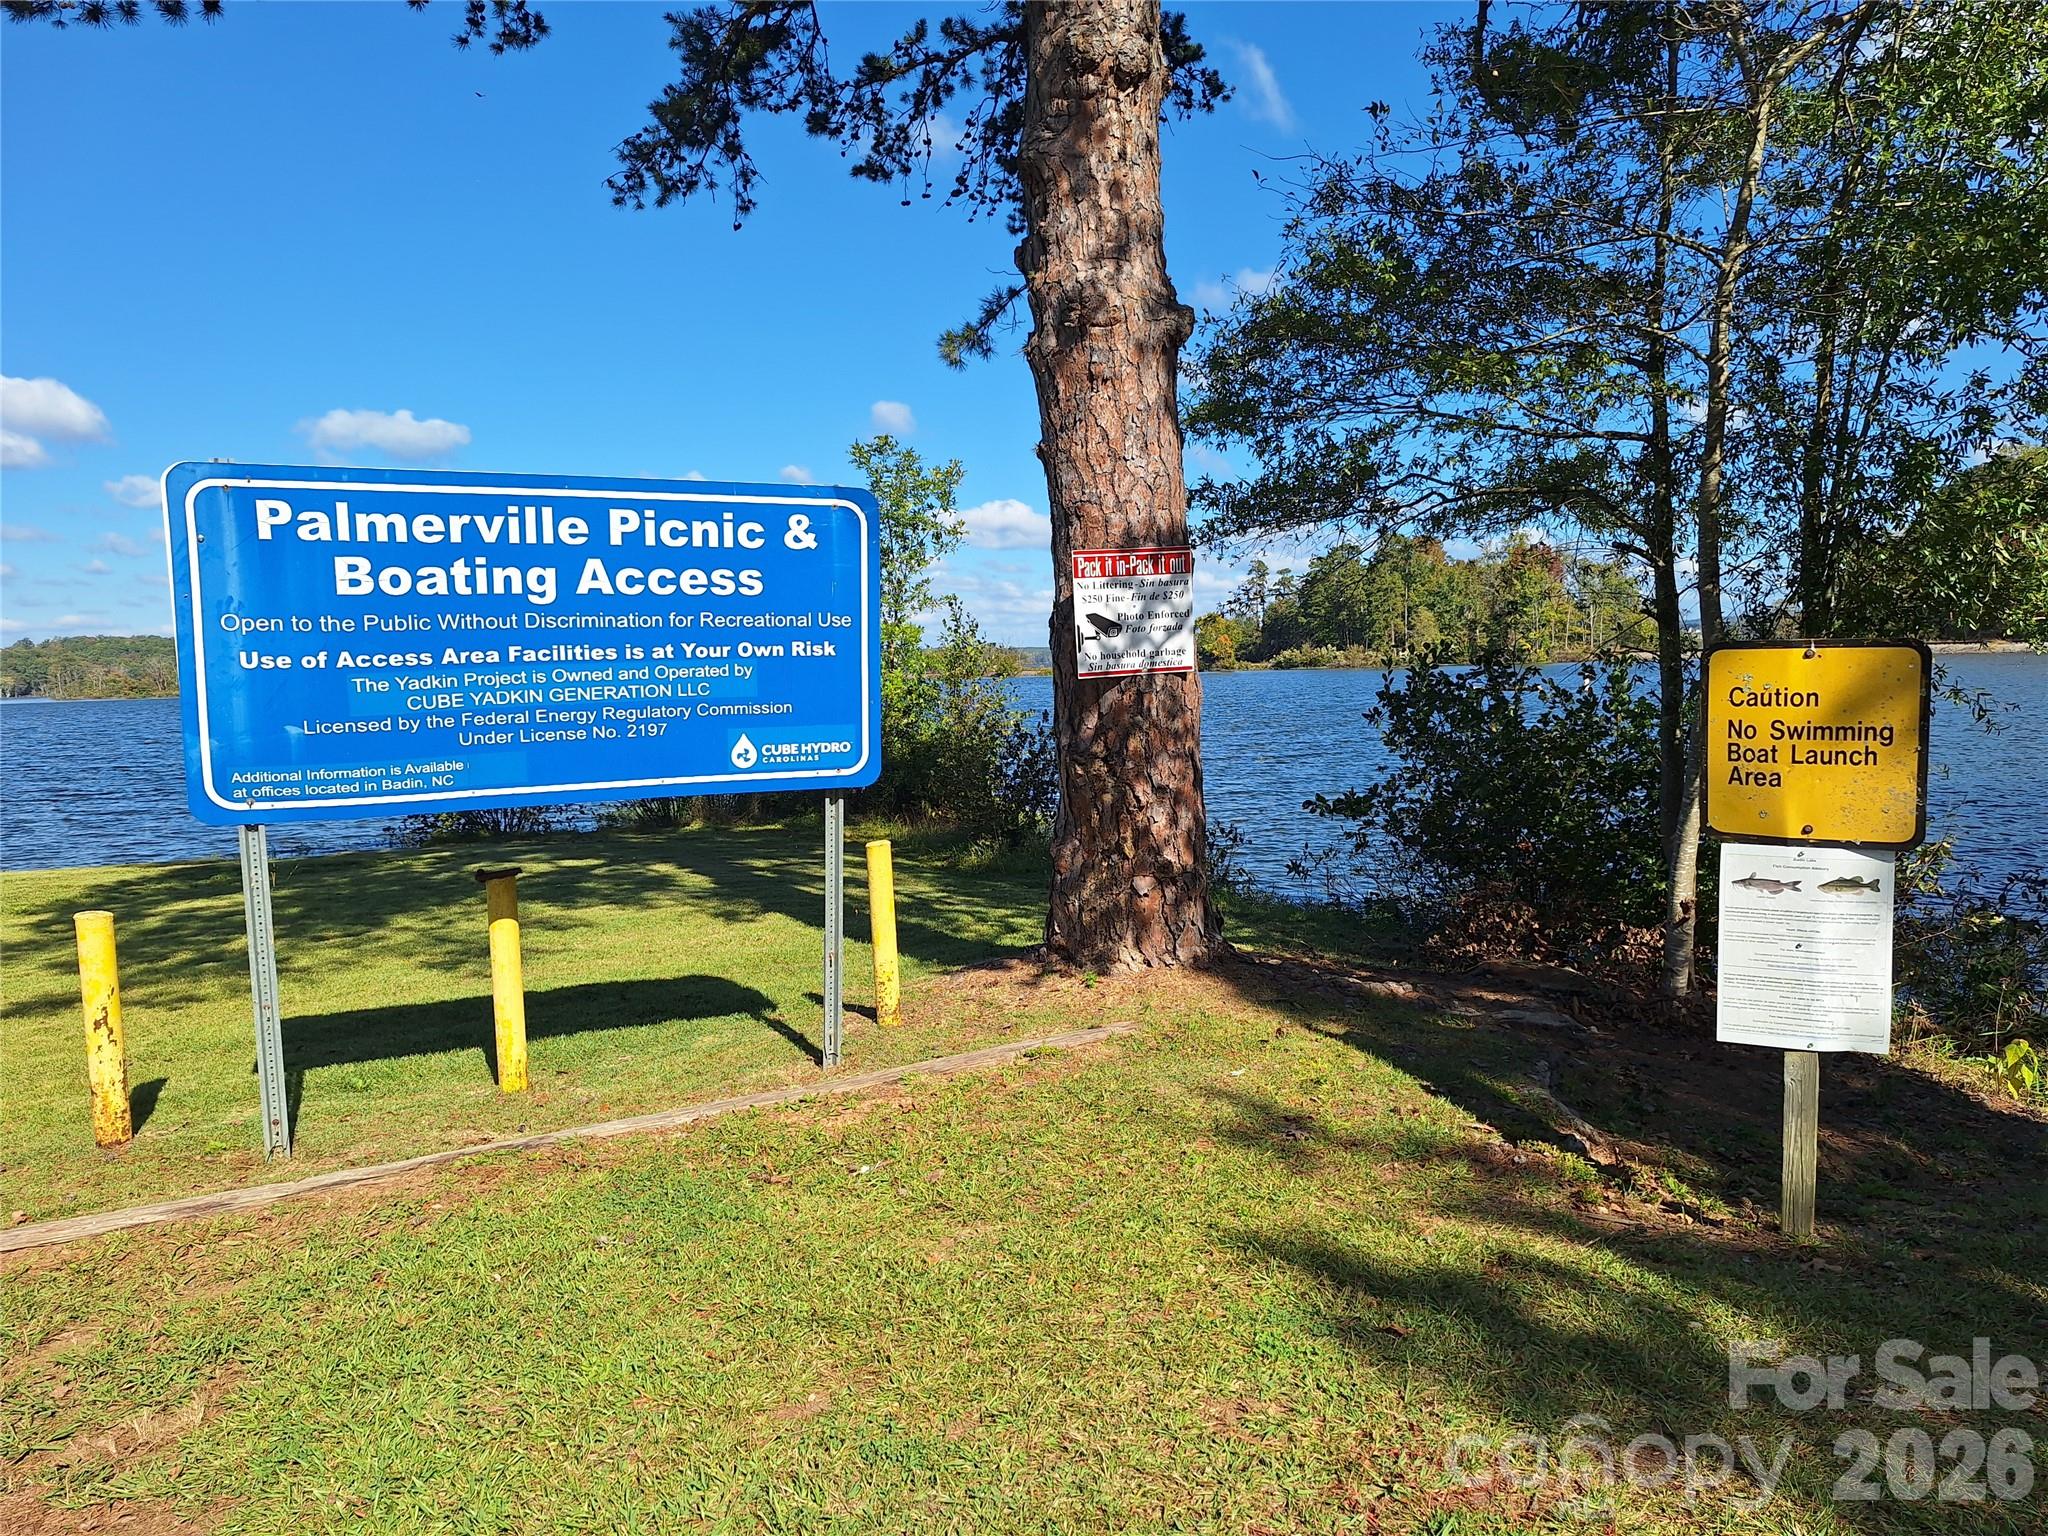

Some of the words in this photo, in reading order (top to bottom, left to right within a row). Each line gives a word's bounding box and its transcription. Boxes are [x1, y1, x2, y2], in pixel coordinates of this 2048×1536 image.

[255, 499, 589, 545] Palmerville
[608, 508, 766, 549] Picnic
[783, 513, 819, 550] &
[1077, 557, 1102, 577] Pack
[1105, 558, 1112, 577] it
[1158, 554, 1166, 574] it
[1170, 554, 1186, 574] out
[334, 556, 557, 605] Boating
[576, 558, 764, 596] Access
[1077, 582, 1089, 590] No
[1158, 578, 1189, 588] basura
[1082, 594, 1103, 604] $250
[1150, 591, 1160, 601] de
[1163, 590, 1184, 600] $250
[220, 613, 284, 635] Open
[291, 615, 313, 632] to
[319, 615, 356, 632] the
[363, 614, 432, 631] Public
[437, 613, 518, 630] Without
[524, 612, 663, 629] Discrimination
[669, 612, 694, 628] for
[700, 611, 812, 628] Recreational
[818, 612, 852, 628] Use
[1117, 612, 1145, 622] Photo
[1148, 609, 1190, 620] Enforced
[1125, 624, 1146, 634] Foto
[1149, 622, 1183, 634] forzada
[239, 651, 292, 669] Use
[301, 651, 328, 669] of
[336, 651, 433, 668] Access
[441, 647, 500, 665] Area
[508, 645, 618, 663] Facilities
[625, 643, 645, 660] is
[652, 643, 674, 659] at
[681, 642, 731, 658] Your
[737, 641, 784, 658] Own
[791, 640, 837, 657] Risk
[1085, 652, 1097, 661] No
[1100, 649, 1146, 660] household
[1149, 648, 1187, 660] garbage
[1088, 662, 1103, 672] Sin
[1106, 660, 1136, 670] basura
[351, 678, 390, 693] The
[394, 674, 458, 692] Yadkin
[464, 671, 528, 689] Project
[532, 670, 547, 684] is
[551, 667, 613, 683] Owned
[618, 666, 649, 680] and
[654, 663, 730, 682] Operated
[734, 664, 753, 679] by
[407, 693, 465, 711] CUBE
[469, 689, 544, 706] YADKIN
[549, 684, 672, 702] GENERATION
[677, 682, 711, 697] LLC
[1728, 686, 1819, 708] Caution
[303, 717, 392, 735] Licensed
[398, 716, 420, 733] by
[426, 715, 455, 729] the
[461, 710, 529, 727] Federal
[535, 708, 597, 725] Energy
[602, 703, 692, 722] Regulatory
[696, 701, 793, 716] Commission
[458, 730, 514, 747] Under
[520, 728, 587, 743] License
[592, 725, 621, 740] No.
[627, 722, 668, 738] 2197
[1727, 719, 1757, 740] No
[1770, 719, 1894, 747] Swimming
[761, 743, 799, 755] CUBE
[801, 741, 851, 754] HYDRO
[762, 754, 820, 764] CAROLINAS
[1727, 742, 1778, 765] Boat
[1791, 743, 1878, 766] Launch
[231, 770, 302, 784] Additional
[306, 767, 386, 781] Information
[390, 764, 402, 776] is
[404, 759, 464, 775] Available
[1727, 766, 1782, 788] Area
[233, 787, 248, 799] at
[251, 783, 301, 798] offices
[305, 781, 360, 795] located
[364, 780, 377, 792] in
[381, 776, 428, 791] Badin,
[431, 774, 455, 787] NC
